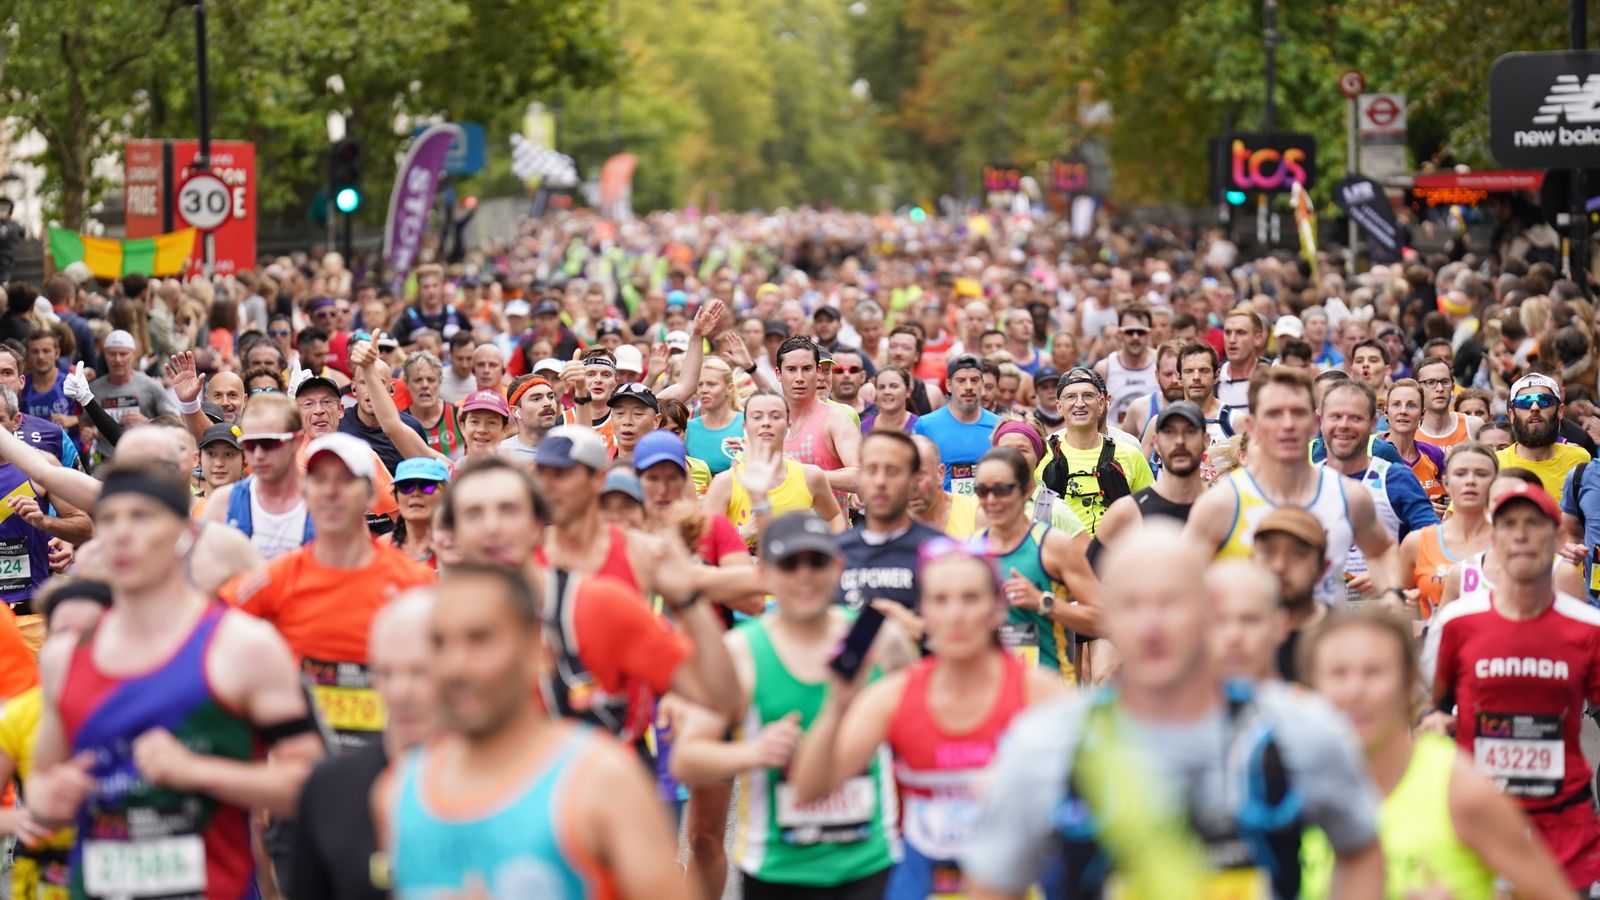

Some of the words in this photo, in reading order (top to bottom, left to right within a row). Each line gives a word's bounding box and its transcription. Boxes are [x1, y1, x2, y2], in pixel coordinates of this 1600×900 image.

[1514, 130, 1556, 147] new
[1232, 139, 1307, 188] tcs
[184, 189, 225, 214] 30
[859, 567, 914, 589] POWER
[1475, 656, 1569, 681] CANADA
[1485, 745, 1552, 771] 43229
